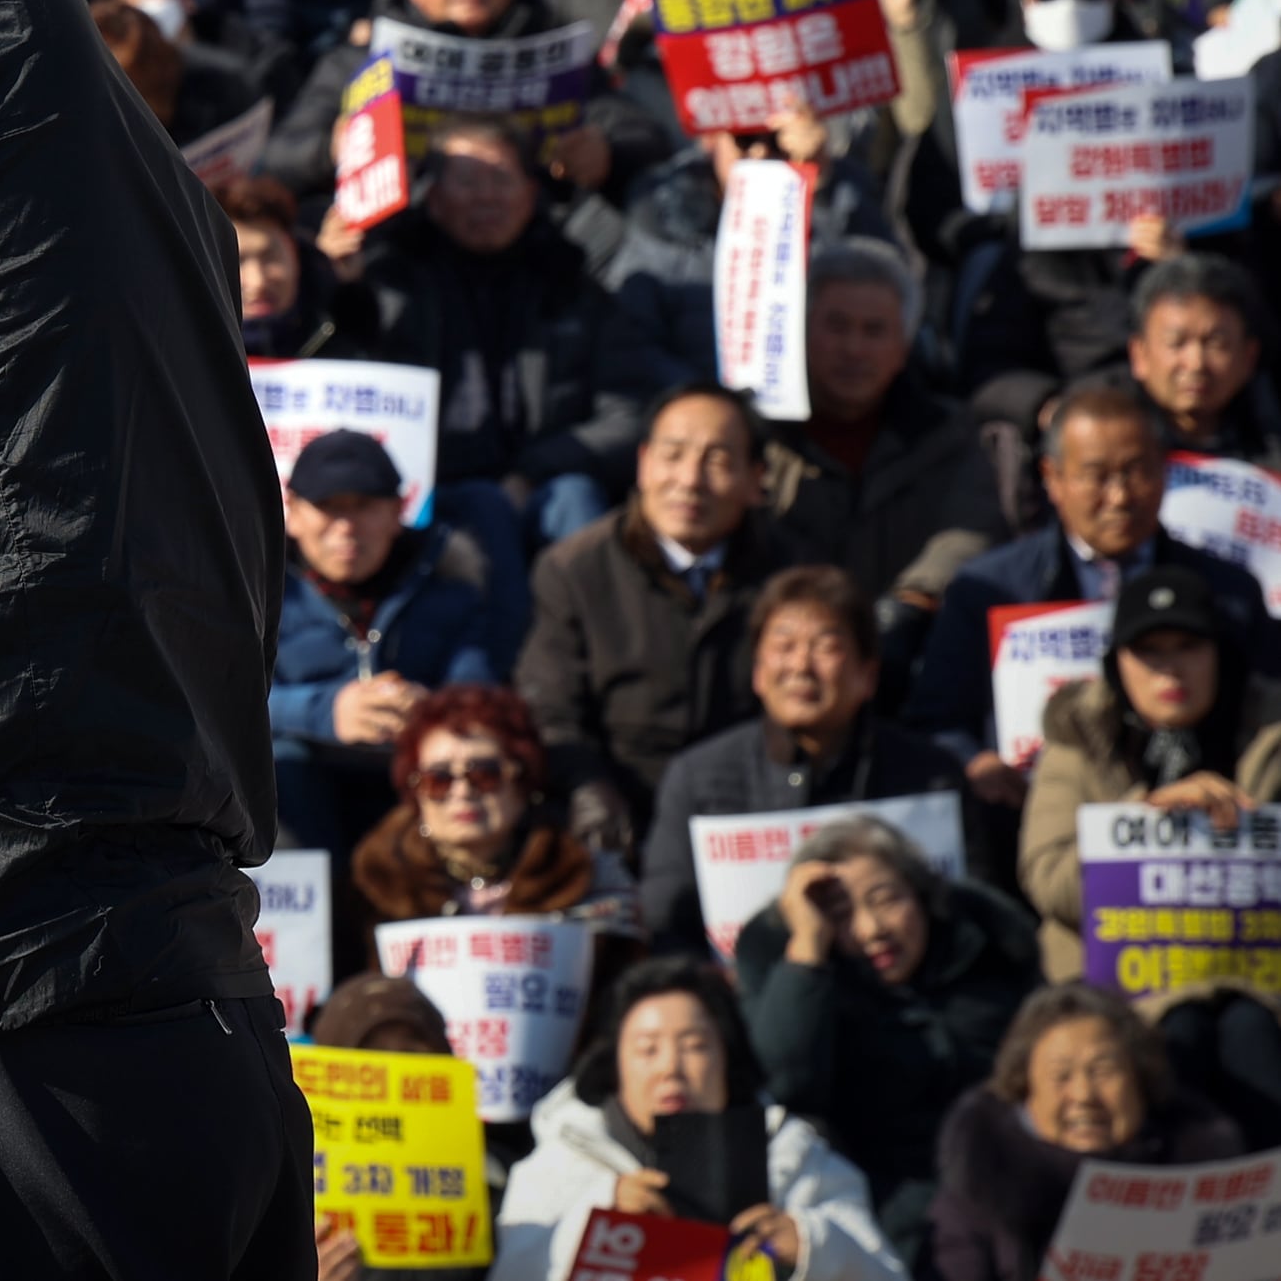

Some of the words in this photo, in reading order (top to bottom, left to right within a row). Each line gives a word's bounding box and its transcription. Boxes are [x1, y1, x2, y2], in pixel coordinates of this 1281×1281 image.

[704, 11, 845, 81] 강원은
[1148, 92, 1246, 129] 차별하나
[1069, 136, 1215, 180] 강원특별법
[1032, 194, 1092, 226] 당장
[324, 381, 426, 421] 차별하나
[705, 826, 792, 862] 이름만
[1111, 813, 1189, 849] 여야
[1092, 906, 1235, 943] 강원특별법
[468, 929, 552, 971] 특별은
[483, 972, 551, 1016] 필요
[295, 1058, 389, 1105] 도민의
[399, 1073, 453, 1106] 삶을
[352, 1113, 405, 1146] 선택
[342, 1164, 394, 1197] 3차
[404, 1165, 466, 1202] 개정
[1086, 1172, 1187, 1213] 이름만
[1192, 1160, 1278, 1206] 특별은
[372, 1212, 478, 1257] 통과!
[1195, 1204, 1258, 1248] 필요
